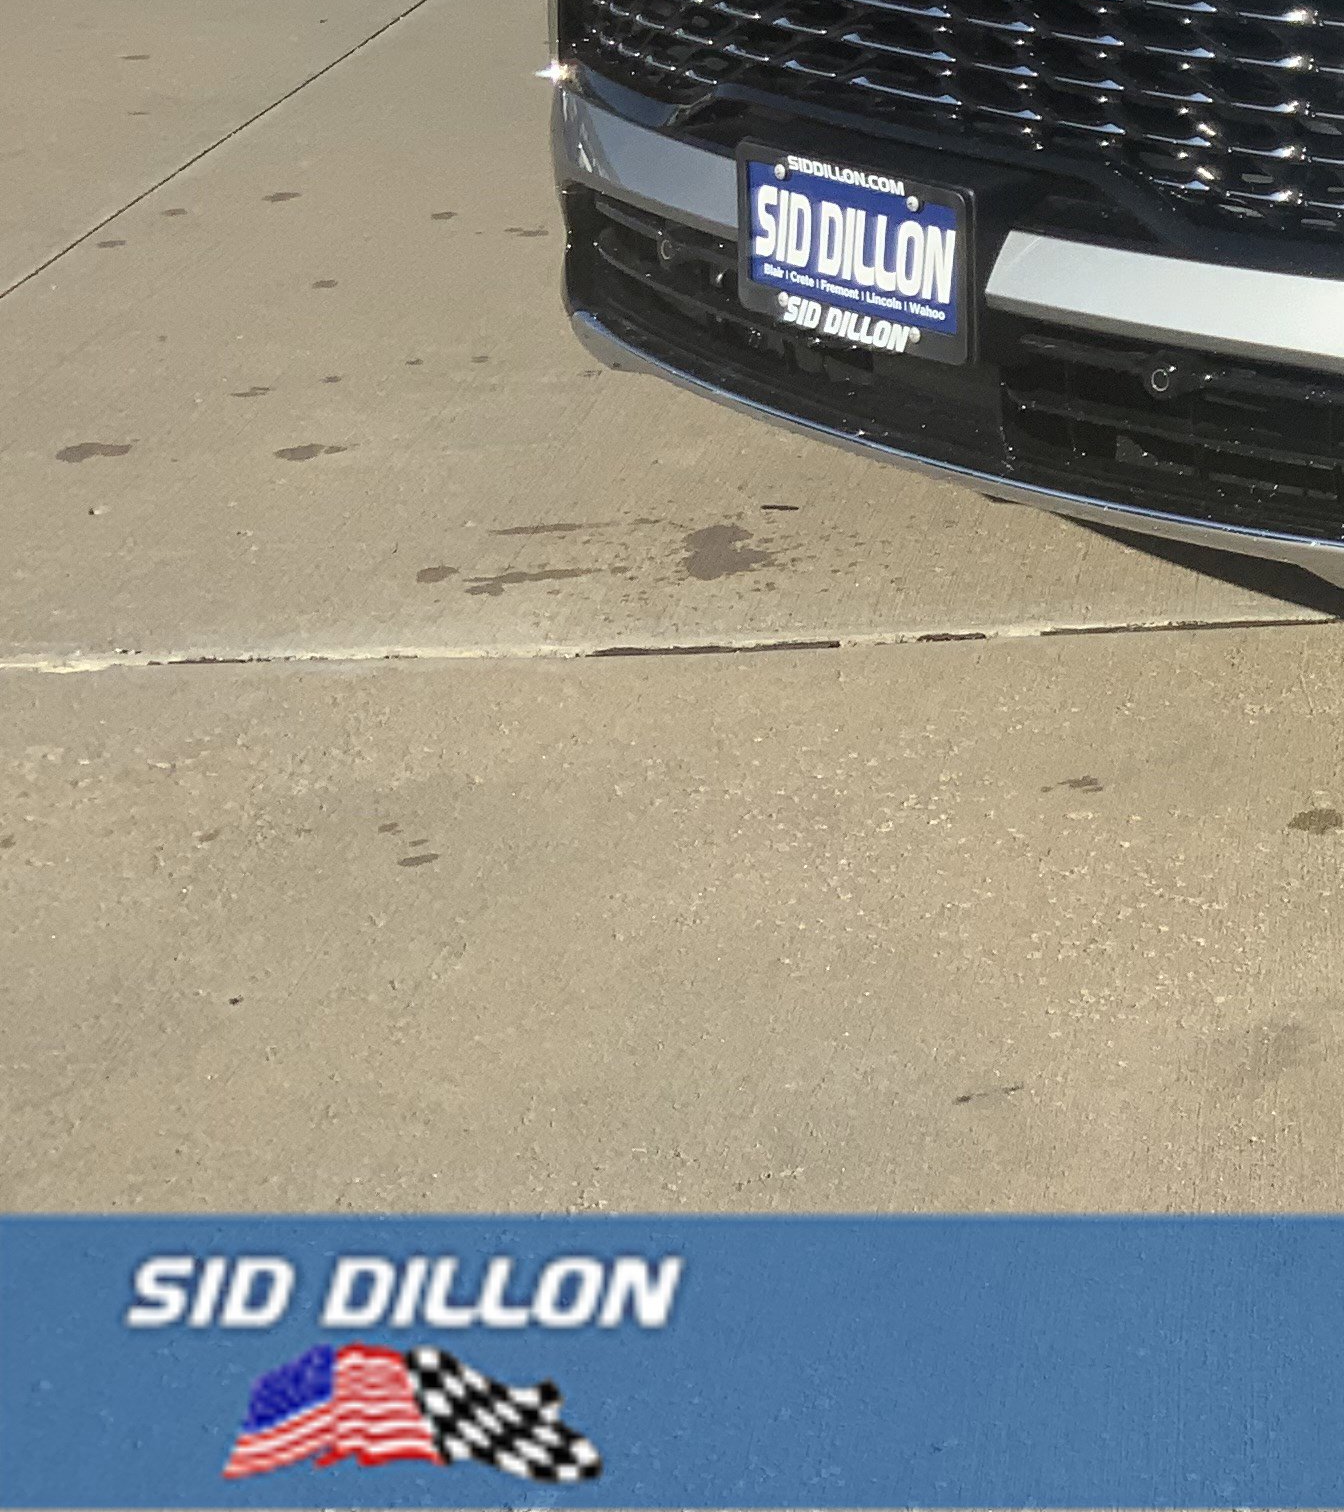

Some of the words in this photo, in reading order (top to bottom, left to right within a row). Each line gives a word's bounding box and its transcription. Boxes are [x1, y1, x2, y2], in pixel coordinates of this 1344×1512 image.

[787, 155, 905, 196] SIDDILLON.COM
[755, 185, 811, 268] SID
[818, 200, 956, 304] DILLON
[763, 263, 784, 278] Blair
[820, 279, 860, 300] Fremont
[866, 291, 902, 310] Lincoln
[909, 301, 946, 321] Wahoo
[783, 296, 821, 329] SID
[824, 307, 910, 353] DILLON
